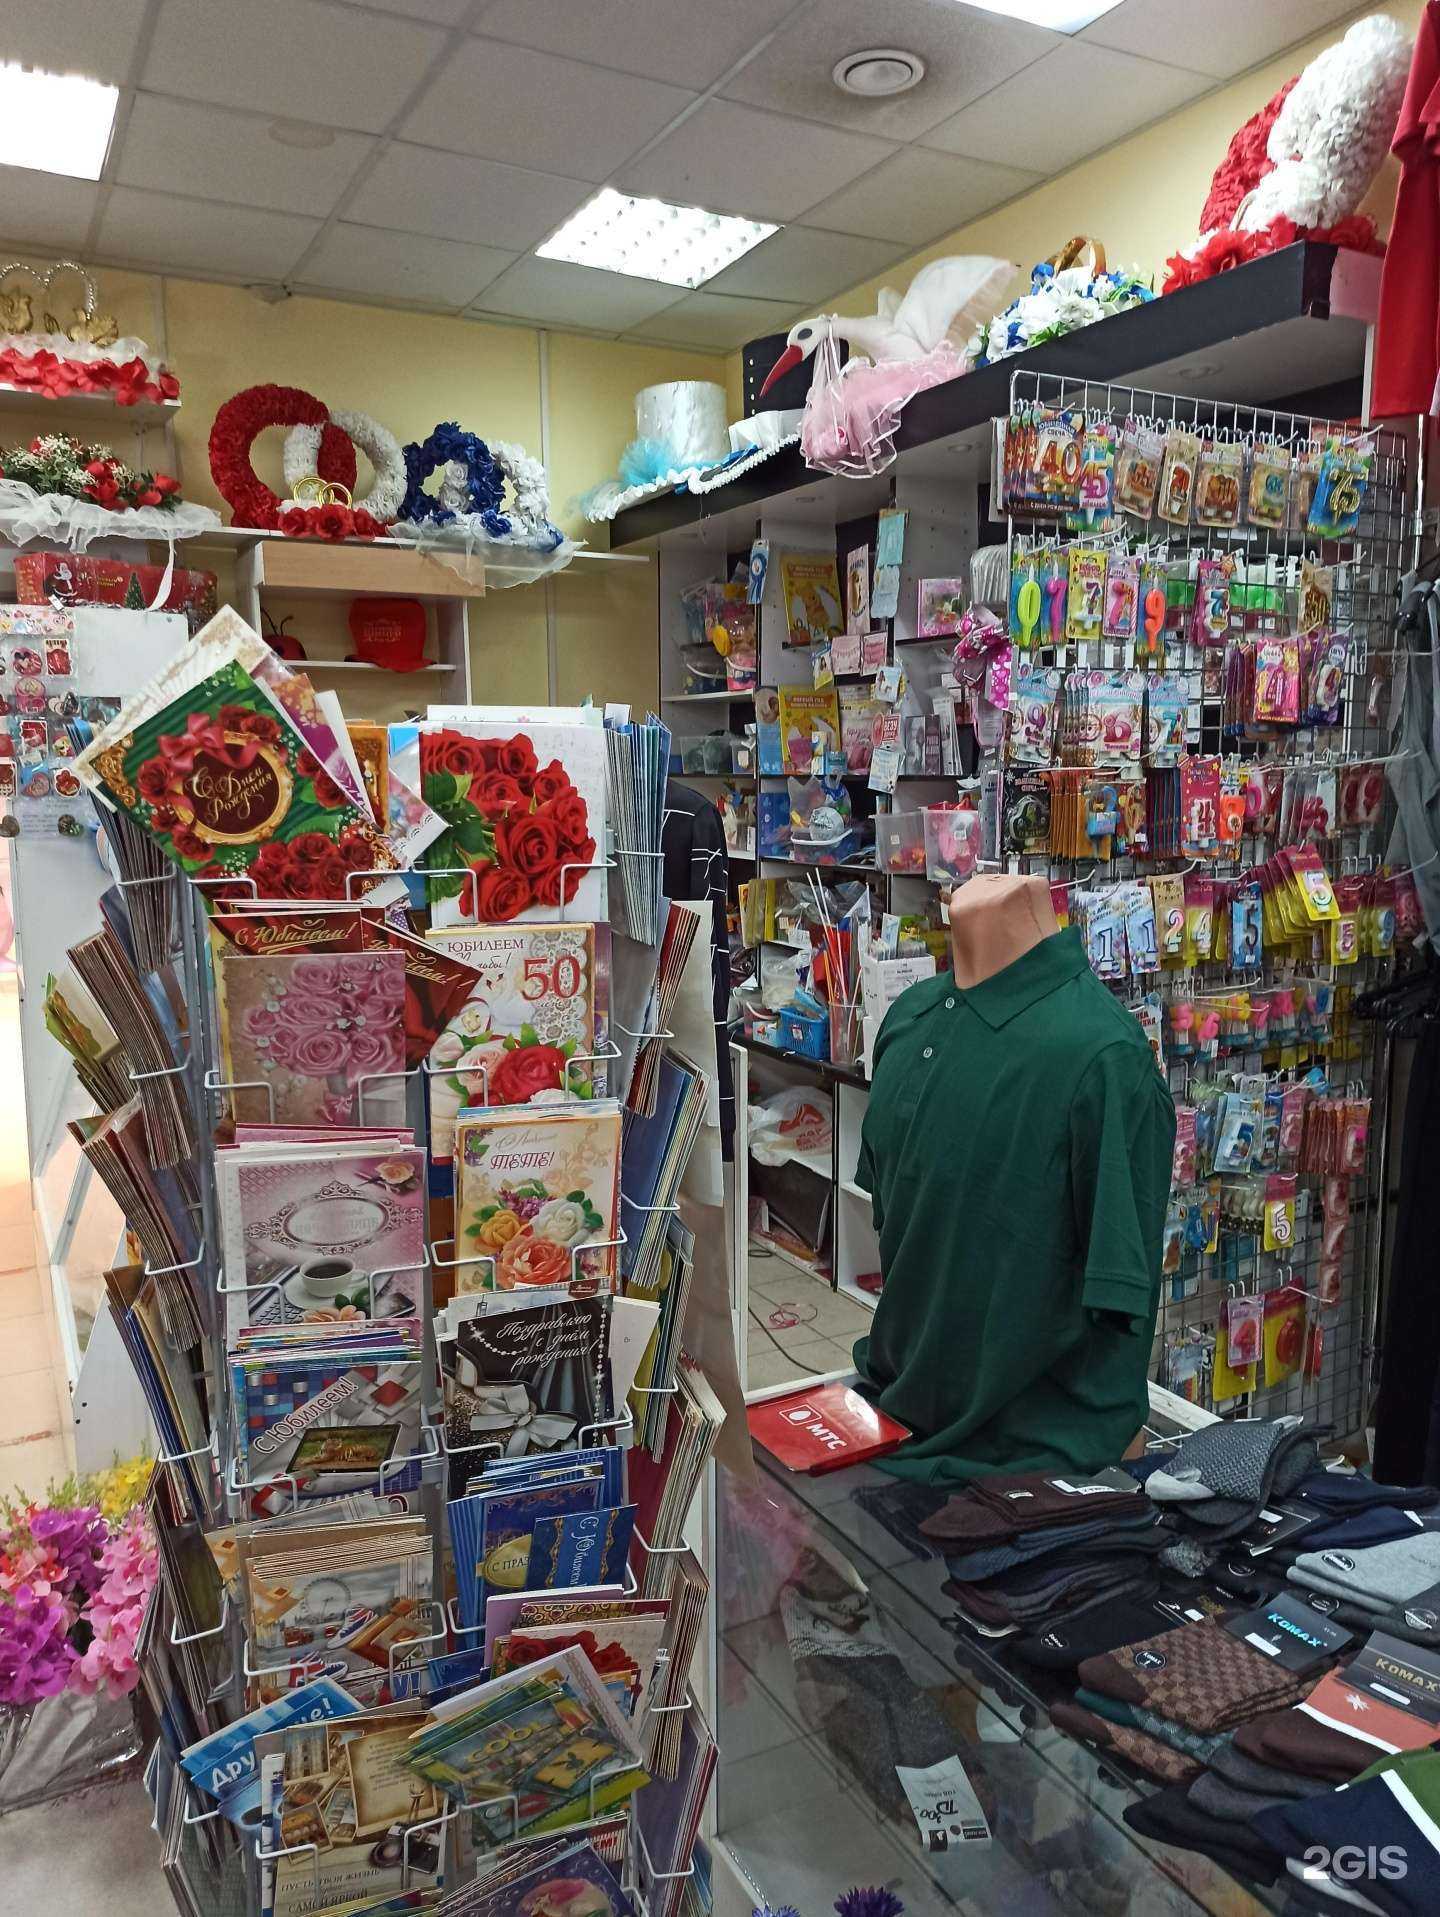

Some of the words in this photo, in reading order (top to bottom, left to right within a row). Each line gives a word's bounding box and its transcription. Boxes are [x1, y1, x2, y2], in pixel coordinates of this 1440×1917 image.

[1040, 440, 1081, 485] 40
[1081, 463, 1109, 499] 45
[235, 928, 249, 946] С
[254, 918, 357, 949] Юбилеем!
[1099, 926, 1115, 962] 1
[1142, 918, 1158, 953] 1
[1165, 908, 1184, 946] 2
[1195, 910, 1213, 948] 4
[1245, 904, 1260, 950] 5
[447, 938, 524, 953] ЮБИЛЕЕМ
[521, 955, 581, 1001] 50
[1273, 1205, 1291, 1242] 5
[497, 1312, 592, 1343] Поздравляю
[535, 1336, 543, 1348] с
[510, 1339, 600, 1373] рождения!
[253, 1436, 276, 1454] С
[265, 1377, 359, 1443] Юбилеем!
[805, 1423, 848, 1450] МТС
[580, 1516, 599, 1530] С
[1267, 1612, 1321, 1648] KOMAX
[1375, 1658, 1438, 1693] KOMAX
